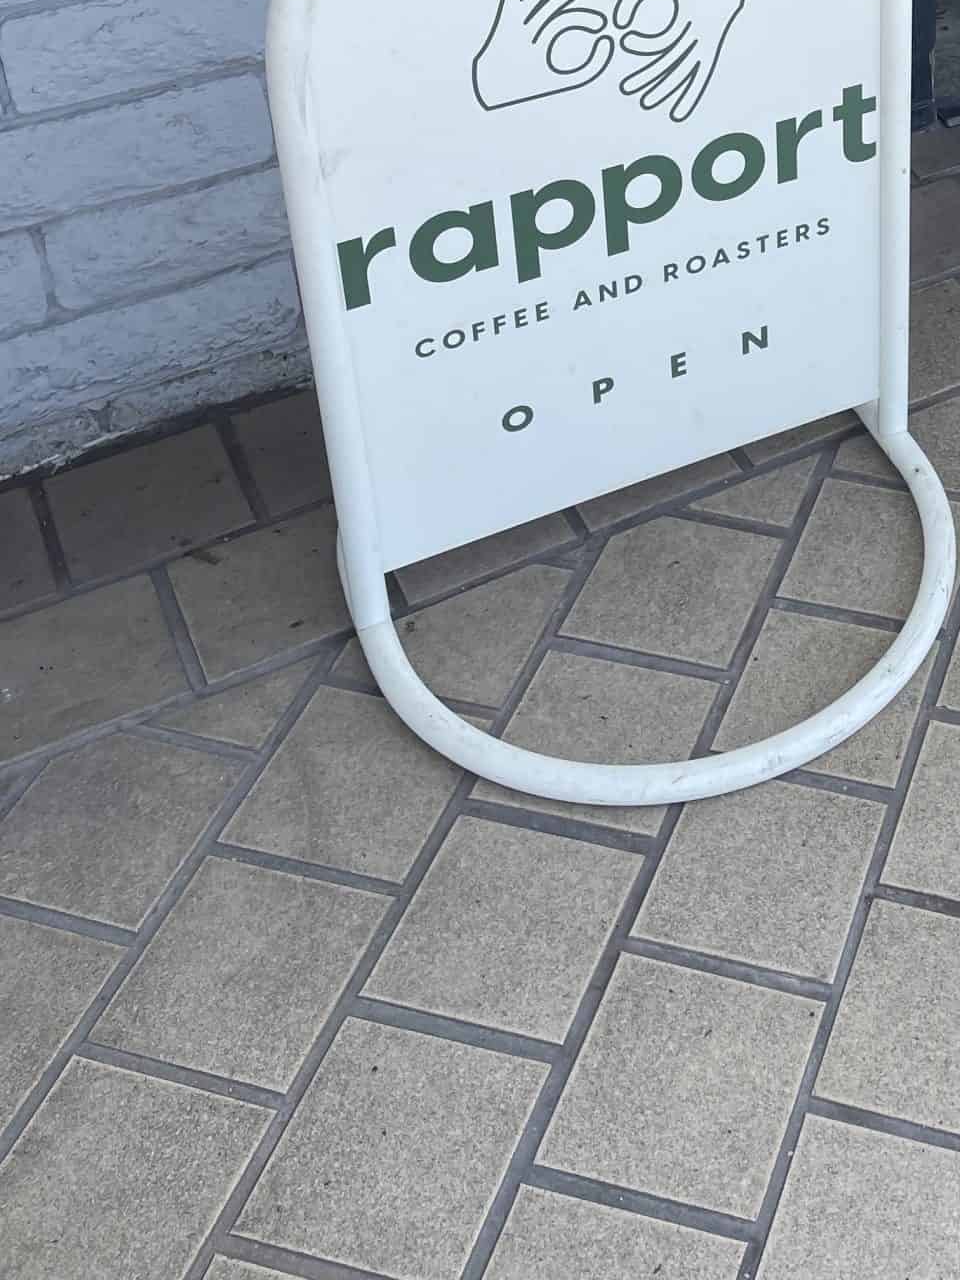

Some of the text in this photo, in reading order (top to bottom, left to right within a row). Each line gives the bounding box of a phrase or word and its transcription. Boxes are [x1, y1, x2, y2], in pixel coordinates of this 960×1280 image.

[337, 84, 877, 311] rapport
[415, 218, 831, 358] COFFEE AND ROASTERS
[502, 325, 769, 432] OPEN
